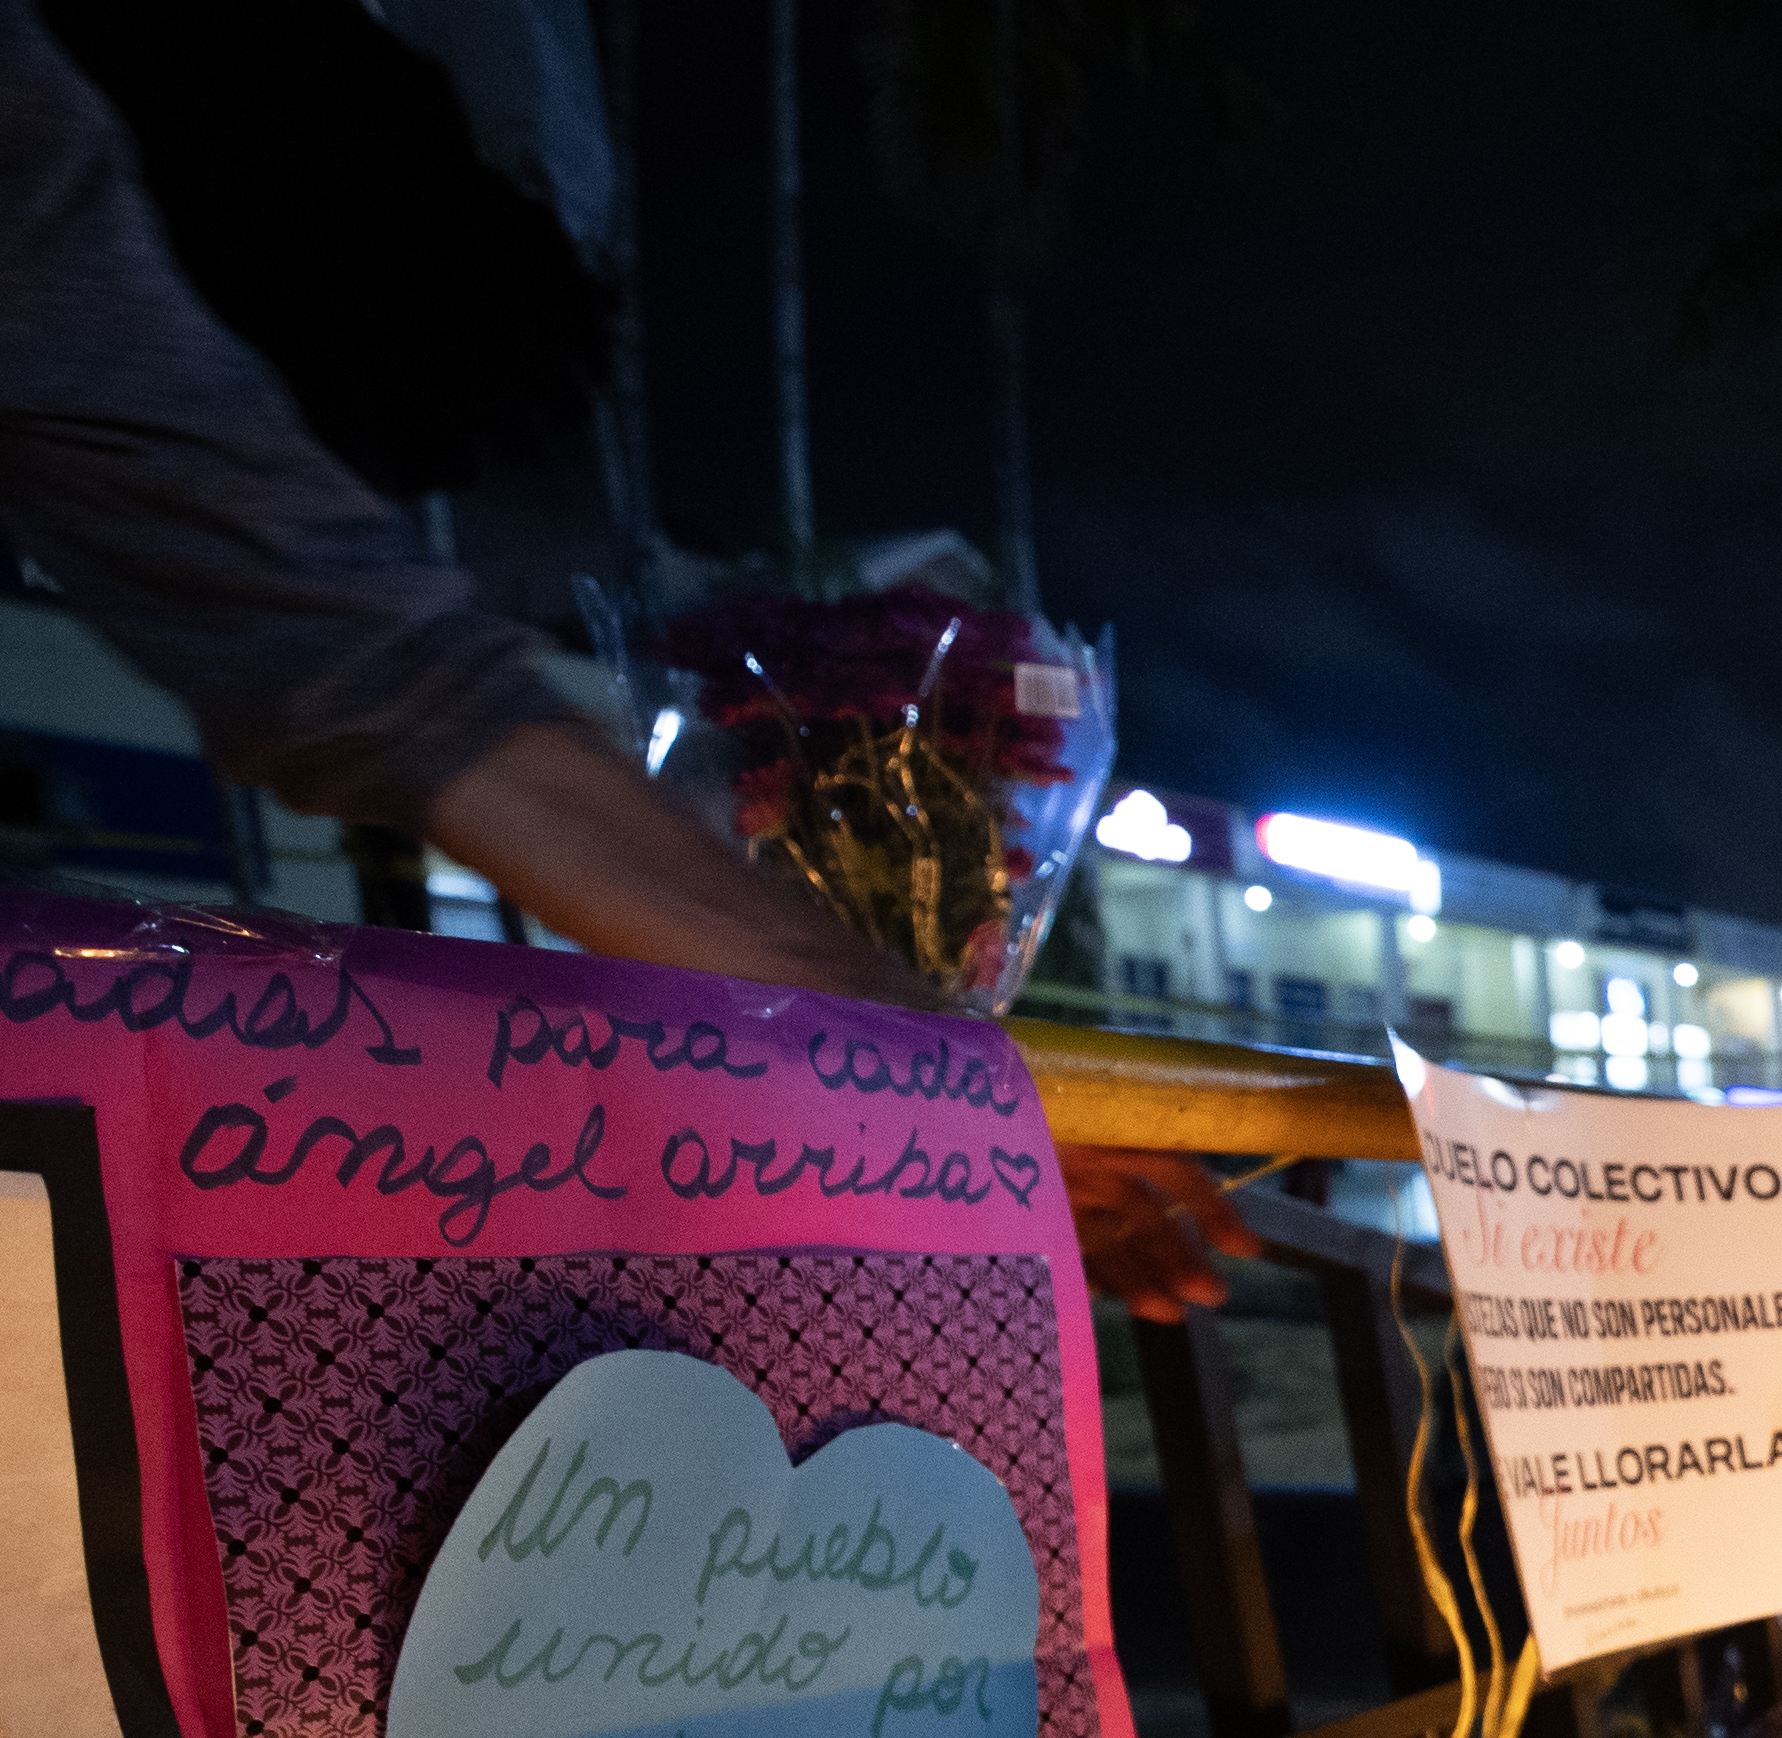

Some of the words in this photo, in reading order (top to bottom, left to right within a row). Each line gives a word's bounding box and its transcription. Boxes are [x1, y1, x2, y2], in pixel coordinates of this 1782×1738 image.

[487, 997, 768, 1089] para
[809, 1031, 1018, 1116] cada
[180, 1075, 628, 1247] ángel
[1526, 1155, 1781, 1202] COLECTIVO
[1520, 1205, 1662, 1275] existe
[1520, 1296, 1558, 1342] QUE
[1559, 1298, 1589, 1339] NO
[1594, 1298, 1640, 1340] SON
[1527, 1366, 1566, 1409] SON
[1566, 1357, 1736, 1408] COMPARTIDAS.
[478, 1438, 653, 1563] Un
[694, 1499, 979, 1609] pueblo
[453, 1614, 851, 1691] unido
